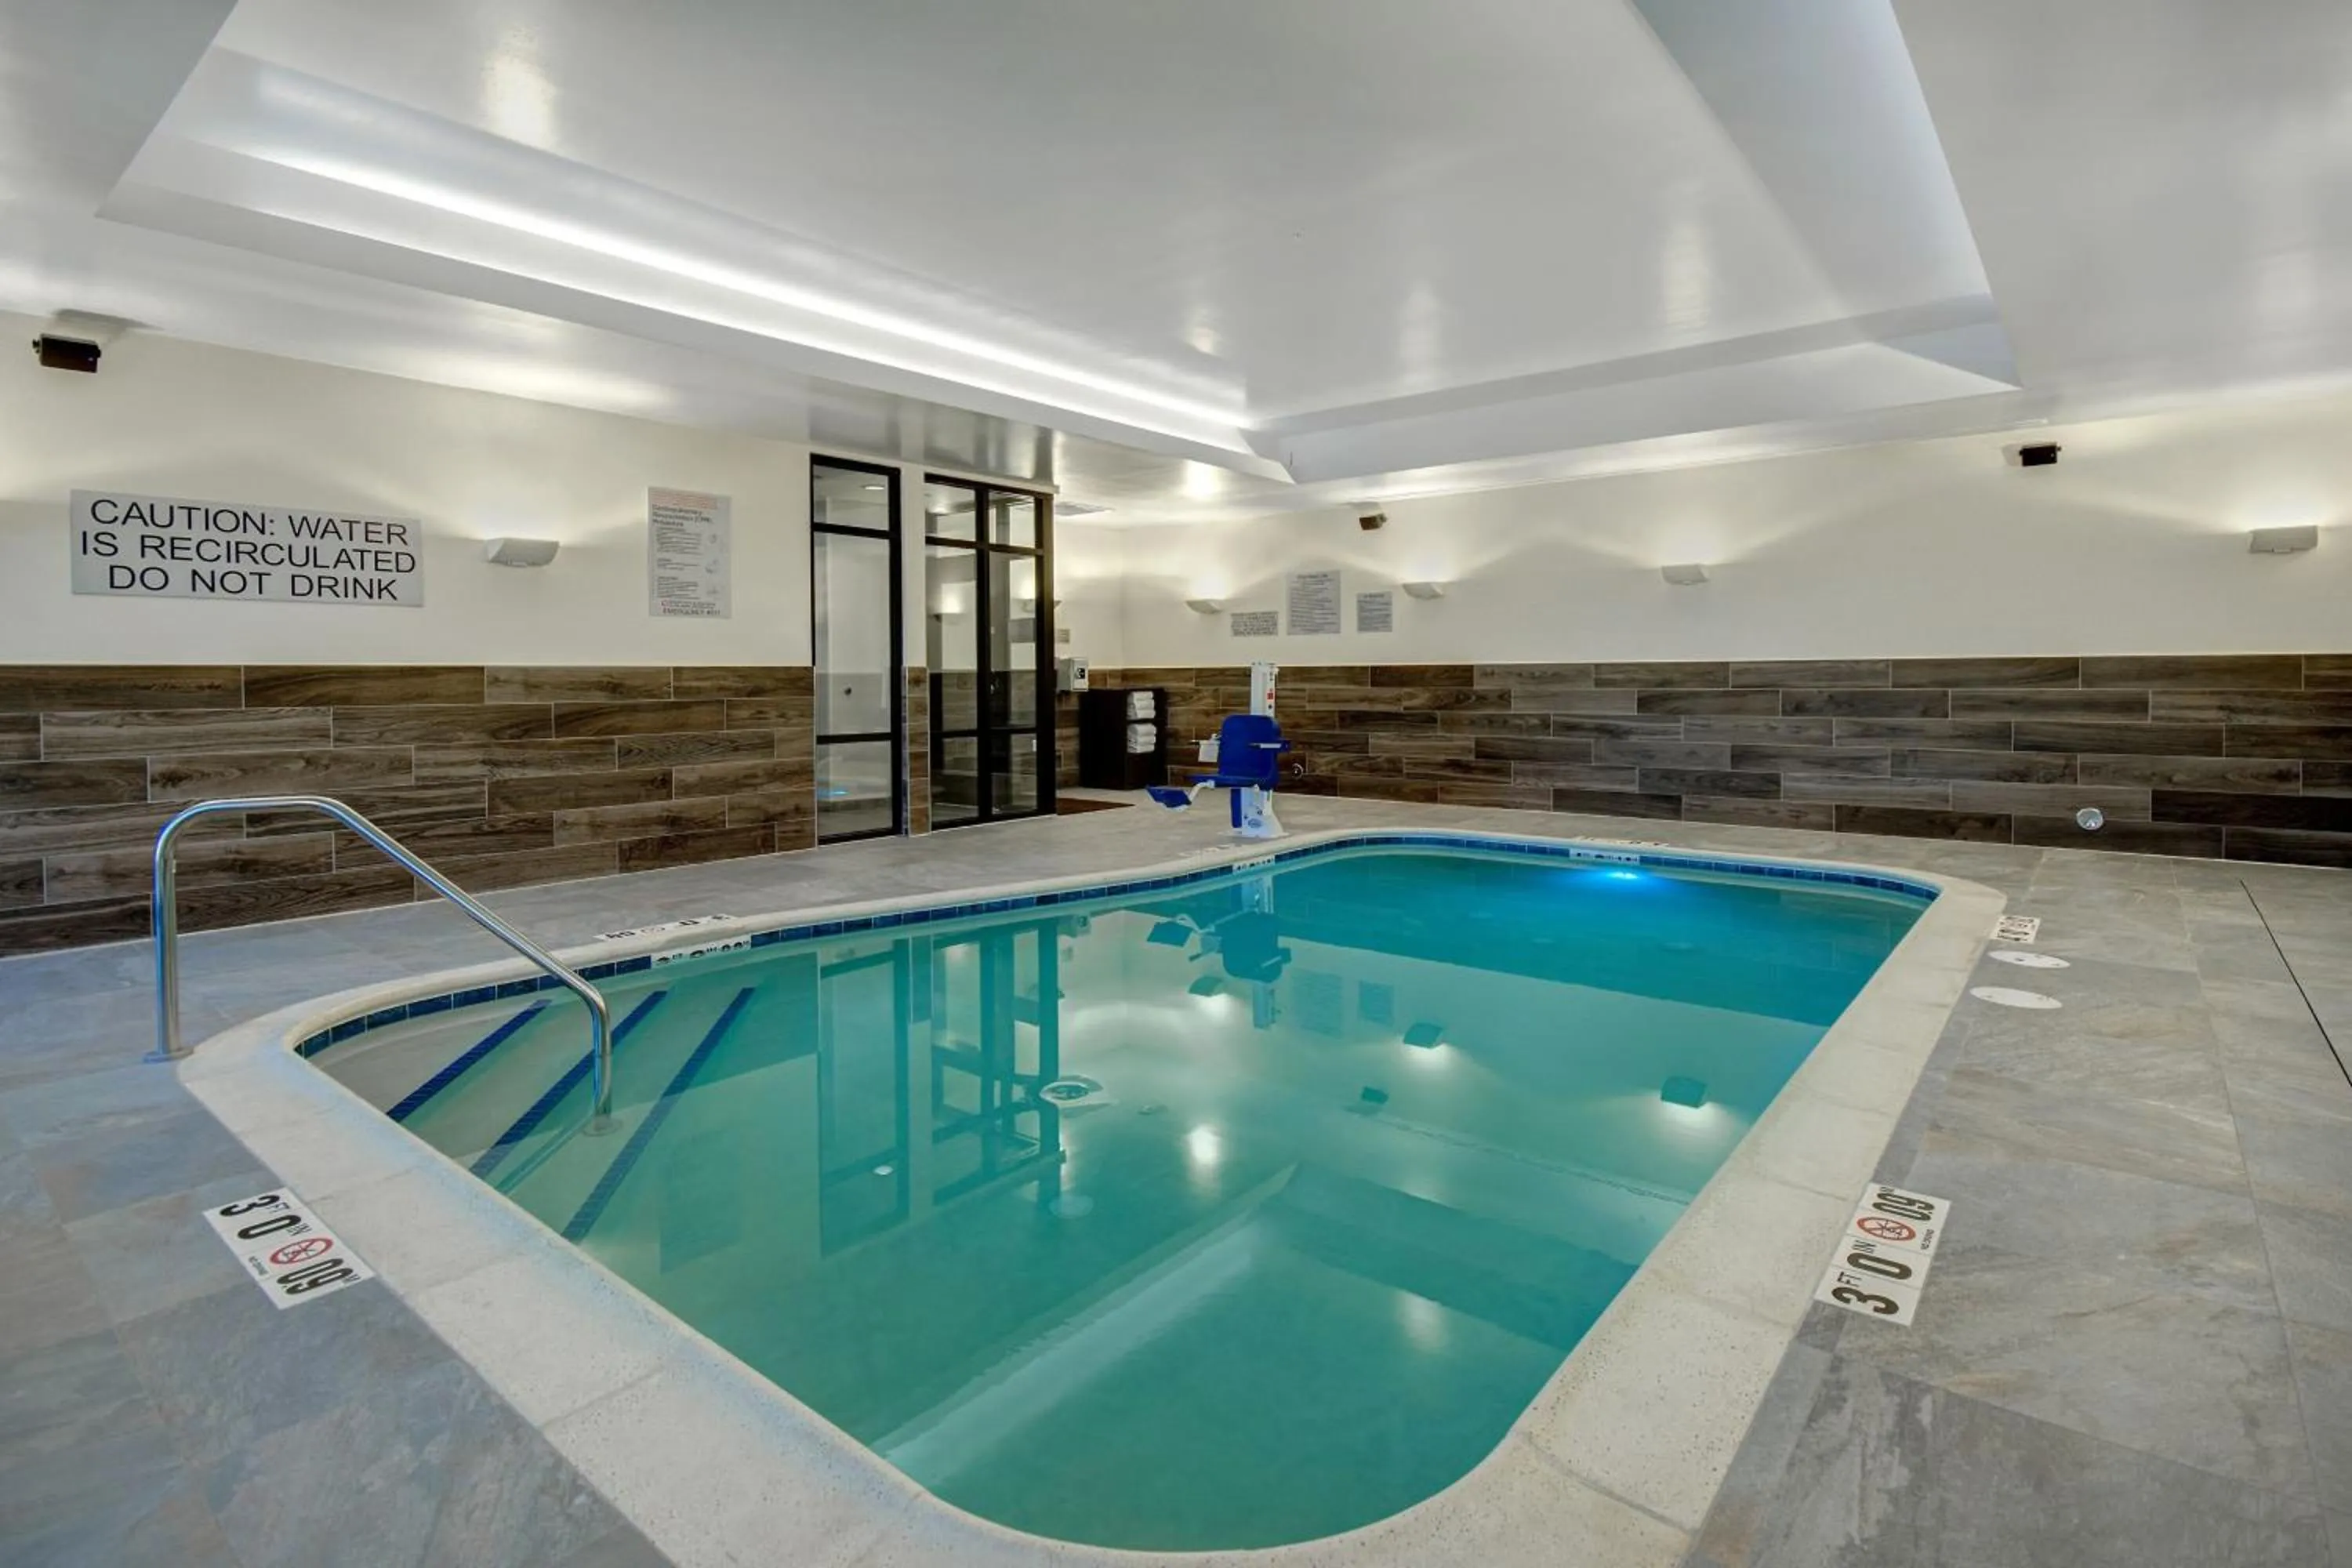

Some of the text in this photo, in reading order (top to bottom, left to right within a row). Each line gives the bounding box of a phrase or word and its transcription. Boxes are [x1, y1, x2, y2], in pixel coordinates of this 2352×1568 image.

[90, 499, 408, 546] CAUTION: WATER
[82, 531, 416, 573] IS RECIRCULATED
[109, 564, 398, 601] DO NOT DRINK
[220, 1194, 280, 1217] 3
[237, 1214, 302, 1240] 0
[1847, 1253, 1912, 1279] 0
[1831, 1287, 1899, 1315] 3
